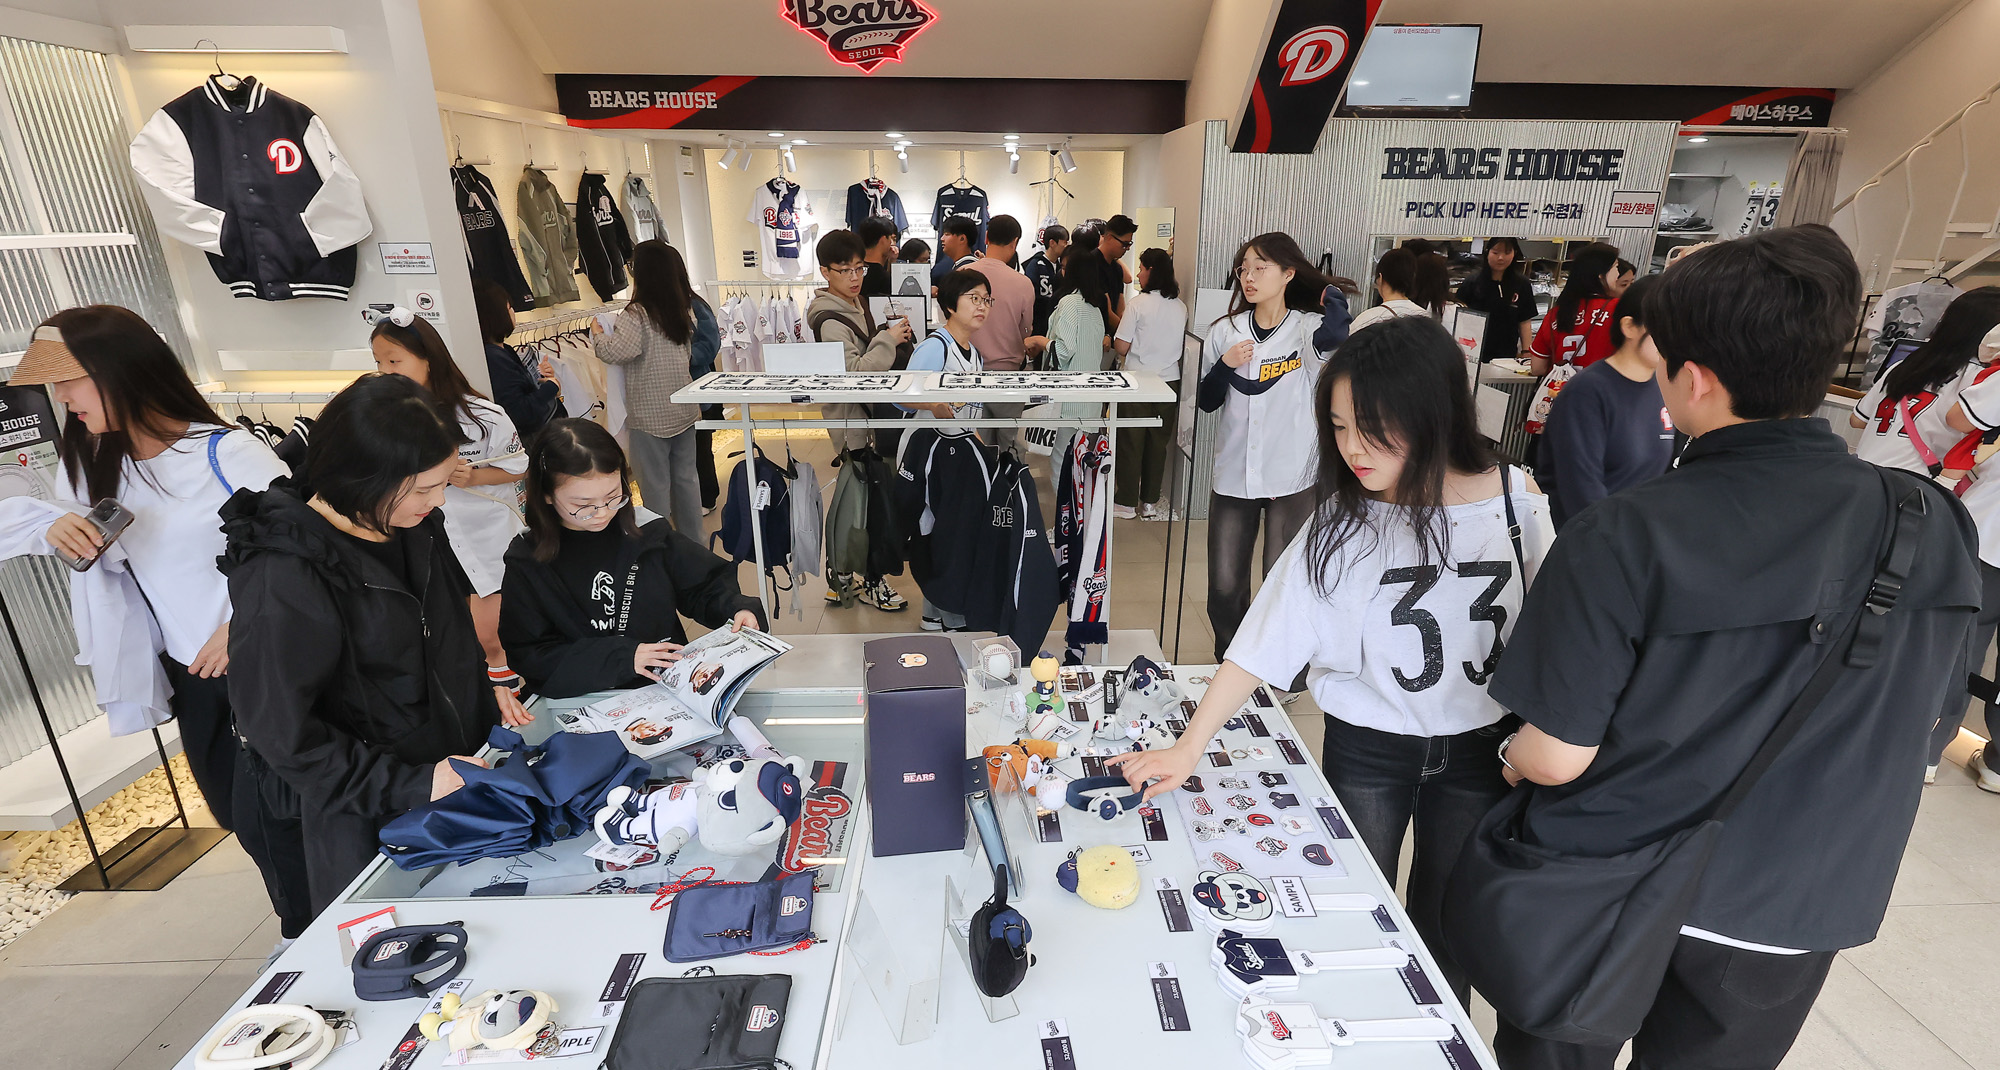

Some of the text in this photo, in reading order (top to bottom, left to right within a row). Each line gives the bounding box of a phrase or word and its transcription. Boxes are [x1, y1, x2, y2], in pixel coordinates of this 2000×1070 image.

[796, 0, 921, 28] Bears
[848, 48, 884, 60] SEOUL
[588, 90, 718, 109] BEARS HOUSE
[1730, 104, 1813, 122] 베어스하우스
[1381, 147, 1624, 181] BEARS HOUSE
[1406, 202, 1583, 220] PICK UP HERE 수령처
[1612, 203, 1656, 215] 교환/환불
[1760, 198, 1780, 226] 3
[1259, 357, 1302, 382] BEARS
[1, 413, 41, 432] HOUSE
[1874, 391, 1939, 438] 47
[23, 429, 37, 440] 안내
[1025, 427, 1056, 448] NIKE
[618, 588, 634, 631] ICEBISCUIT
[1379, 560, 1512, 692] 33
[903, 774, 936, 783] BEARS
[1282, 879, 1304, 912] SAMPLE
[1236, 943, 1264, 970] Seoul
[1301, 953, 1314, 968] Bears
[752, 1008, 761, 1028] HUNTER
[1267, 1010, 1292, 1040] Bears
[1333, 1020, 1347, 1038] Bears
[559, 1036, 594, 1048] MPLE
[1062, 1043, 1070, 1060] 32,000
